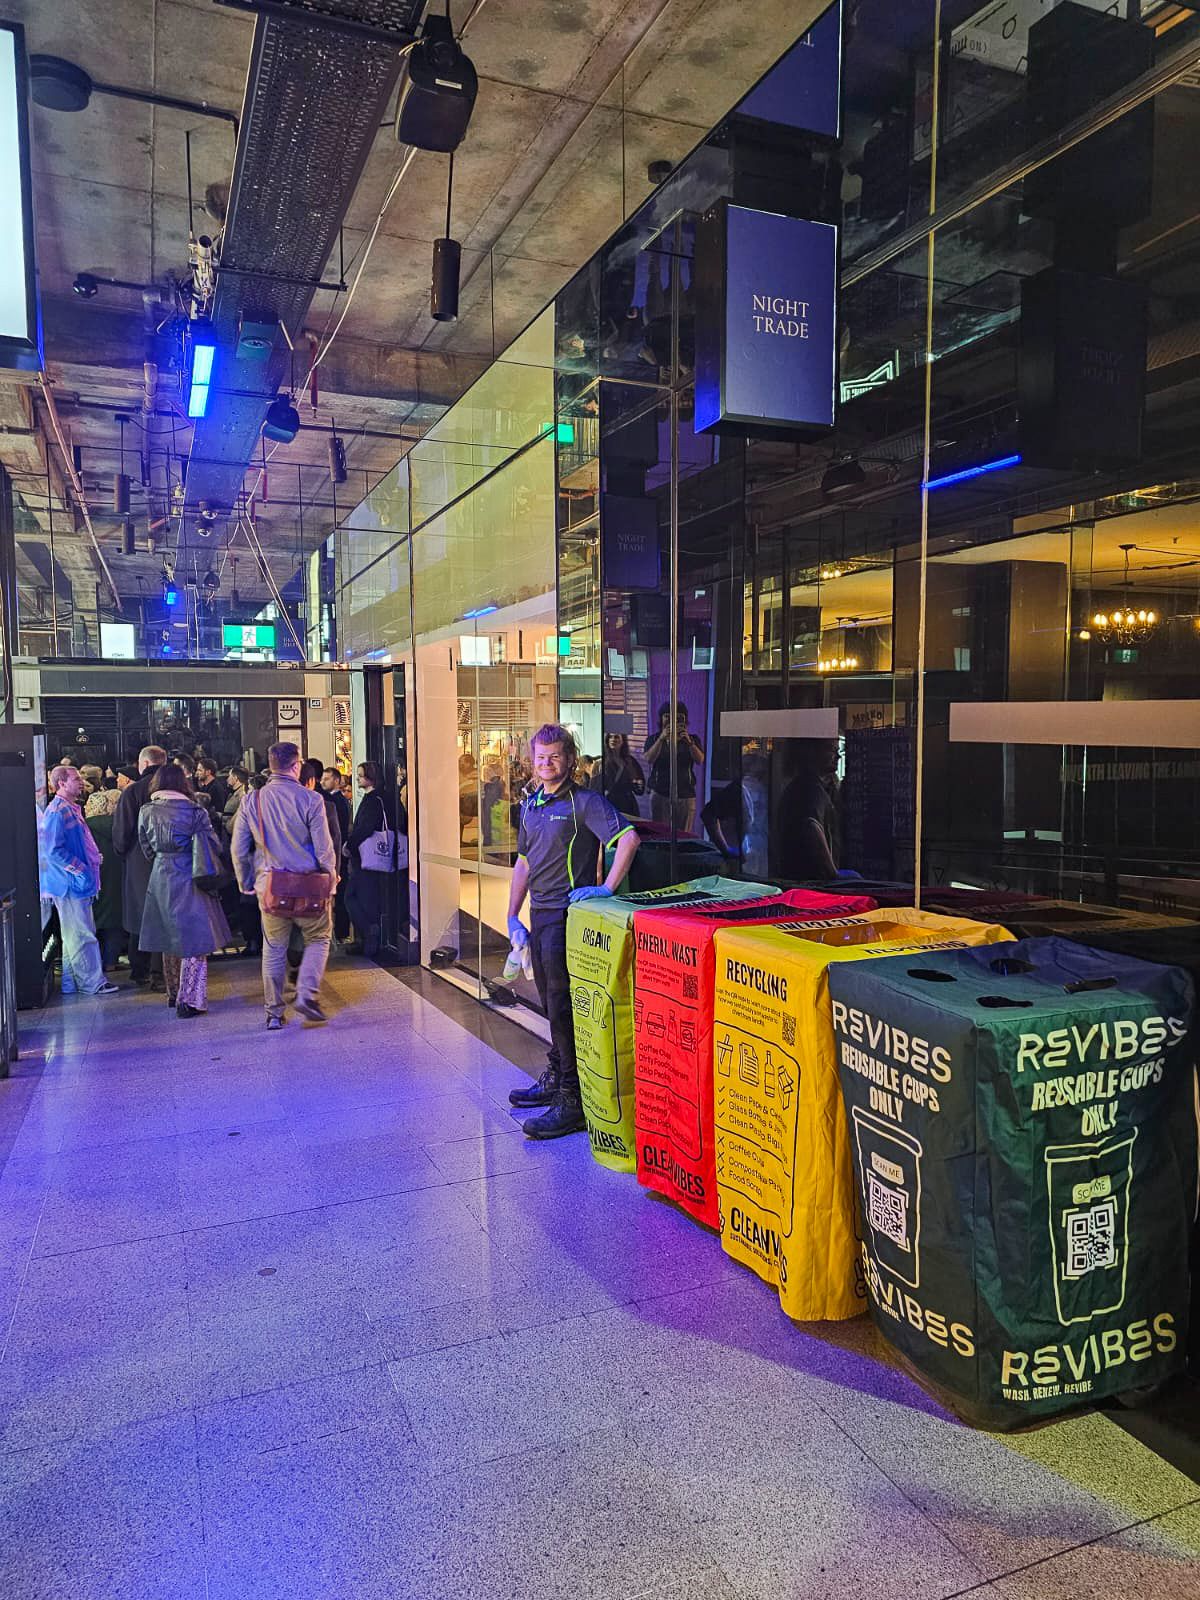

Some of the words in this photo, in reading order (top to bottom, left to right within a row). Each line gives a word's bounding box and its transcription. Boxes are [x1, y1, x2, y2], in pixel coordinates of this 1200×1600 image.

[752, 294, 809, 318] NIGHT
[752, 315, 809, 339] TRADE
[582, 927, 612, 953] ORGANIC
[636, 931, 670, 958] ENERAL
[671, 940, 698, 967] WAST
[726, 958, 787, 1003] RECYCLING
[832, 1000, 952, 1083] REVIBES
[1017, 1016, 1188, 1072] REVIBES
[841, 1041, 900, 1093] REUSABLE
[901, 1073, 940, 1112] CUPS
[1031, 1069, 1120, 1111] REUSABLE
[1119, 1057, 1166, 1092] CUPS
[729, 1088, 748, 1103] Clean
[869, 1086, 903, 1123] ONLY
[728, 1115, 748, 1129] Clean
[1081, 1100, 1119, 1136] ONLY
[729, 1169, 746, 1185] Food
[888, 1168, 901, 1178] ME
[731, 1207, 788, 1283] CLEANVS
[862, 1240, 975, 1357] REVIBES
[1001, 1312, 1177, 1386] REVIBES
